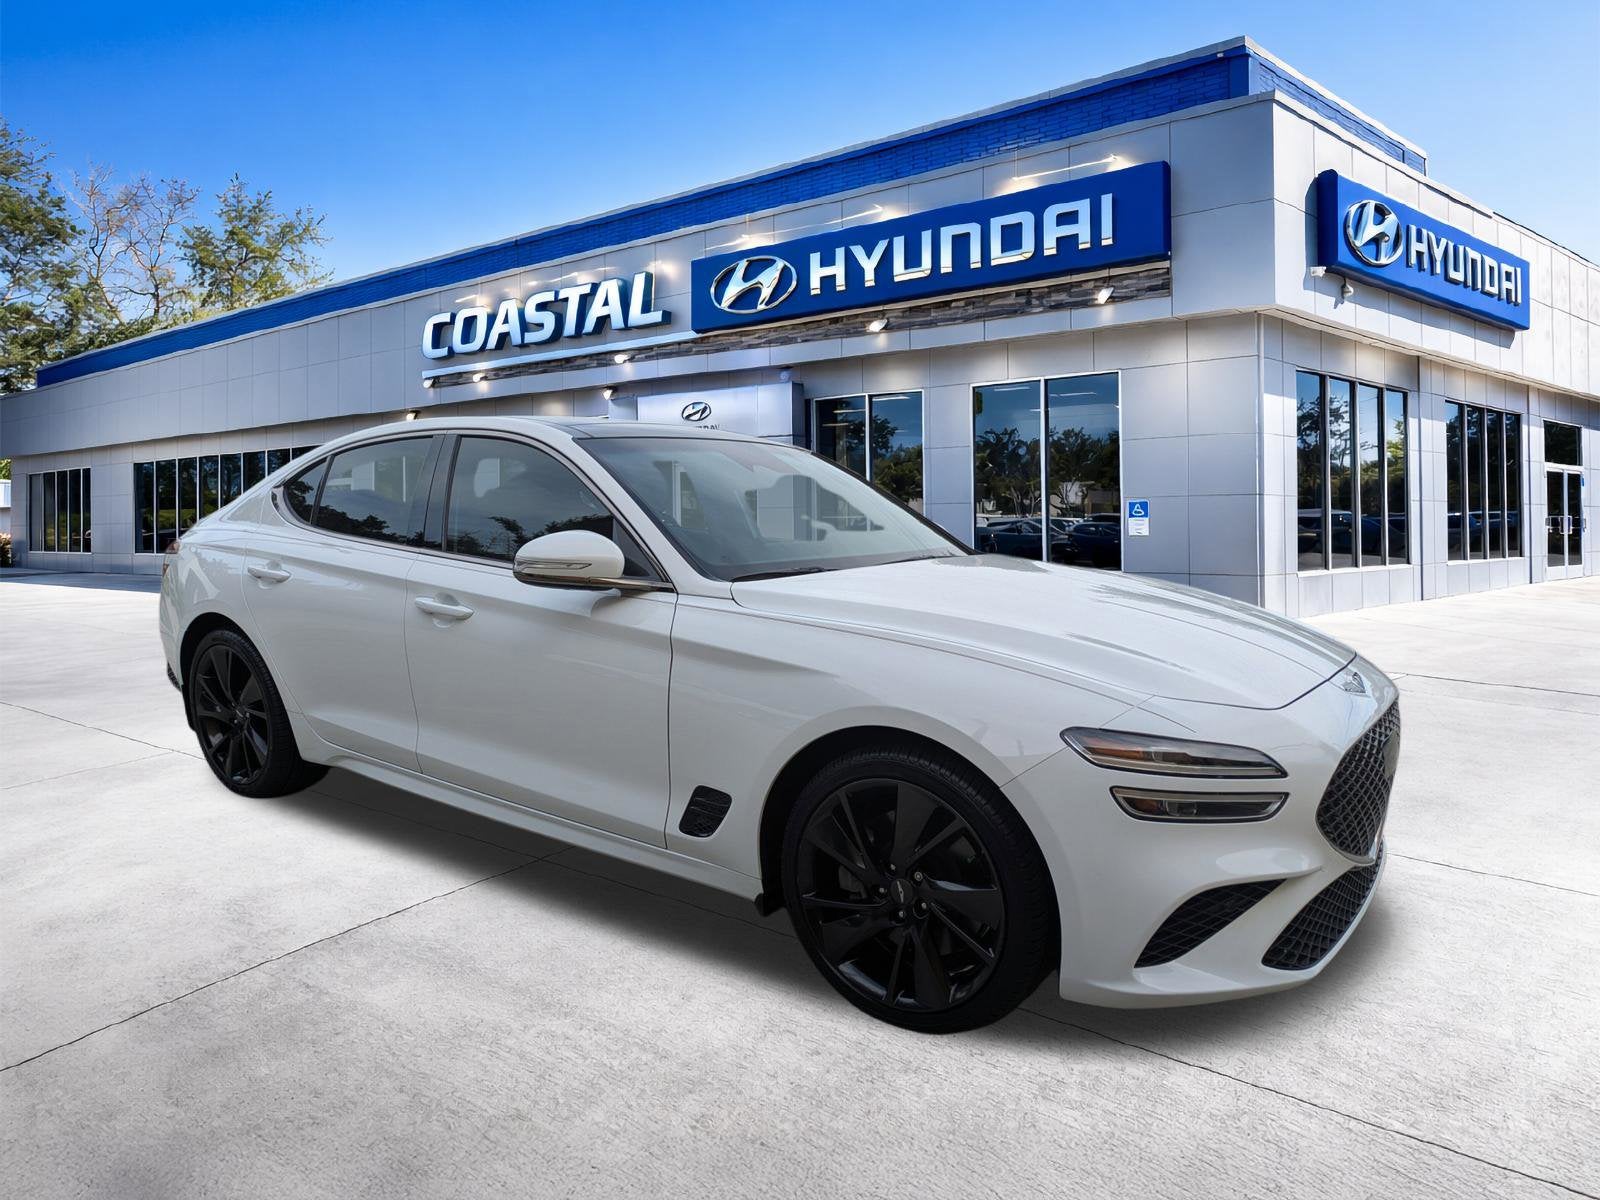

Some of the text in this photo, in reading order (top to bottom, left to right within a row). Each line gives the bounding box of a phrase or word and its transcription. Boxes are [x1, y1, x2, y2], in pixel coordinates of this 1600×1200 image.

[809, 193, 1113, 295] HYUNDAI
[1408, 225, 1521, 305] HYUNDAI
[422, 271, 668, 360] COASTAL
